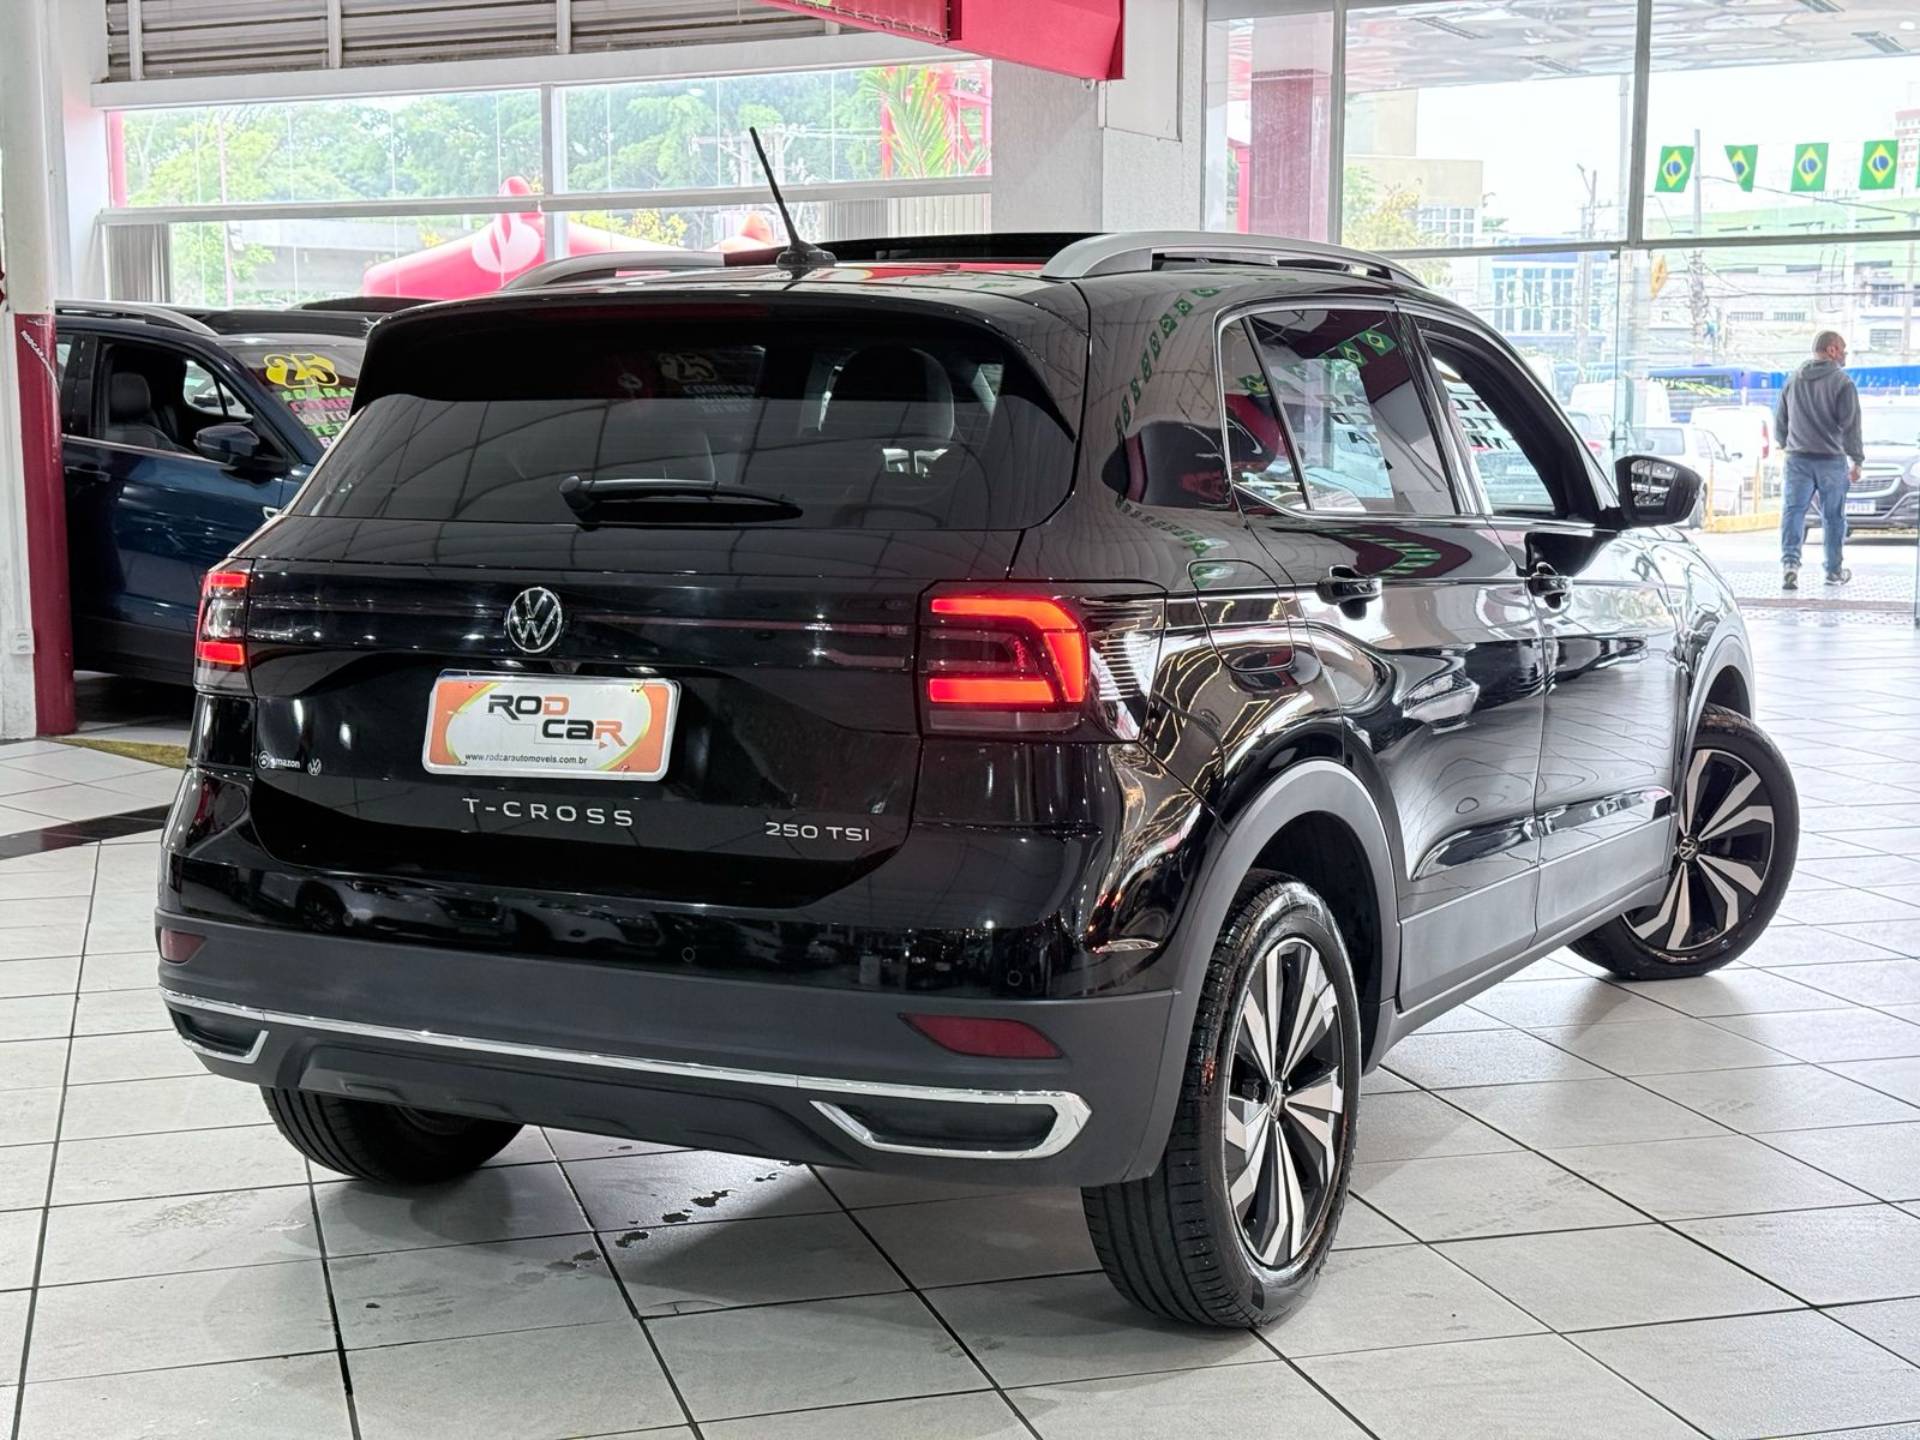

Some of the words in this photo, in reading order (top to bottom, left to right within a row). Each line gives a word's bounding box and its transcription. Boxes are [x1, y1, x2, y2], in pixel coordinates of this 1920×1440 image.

[488, 694, 570, 720] ROD
[465, 752, 587, 764] www.rodcarautomoveis.com.br
[462, 797, 633, 827] T-CROSS
[765, 822, 818, 838] 250
[825, 826, 870, 841] TSI
